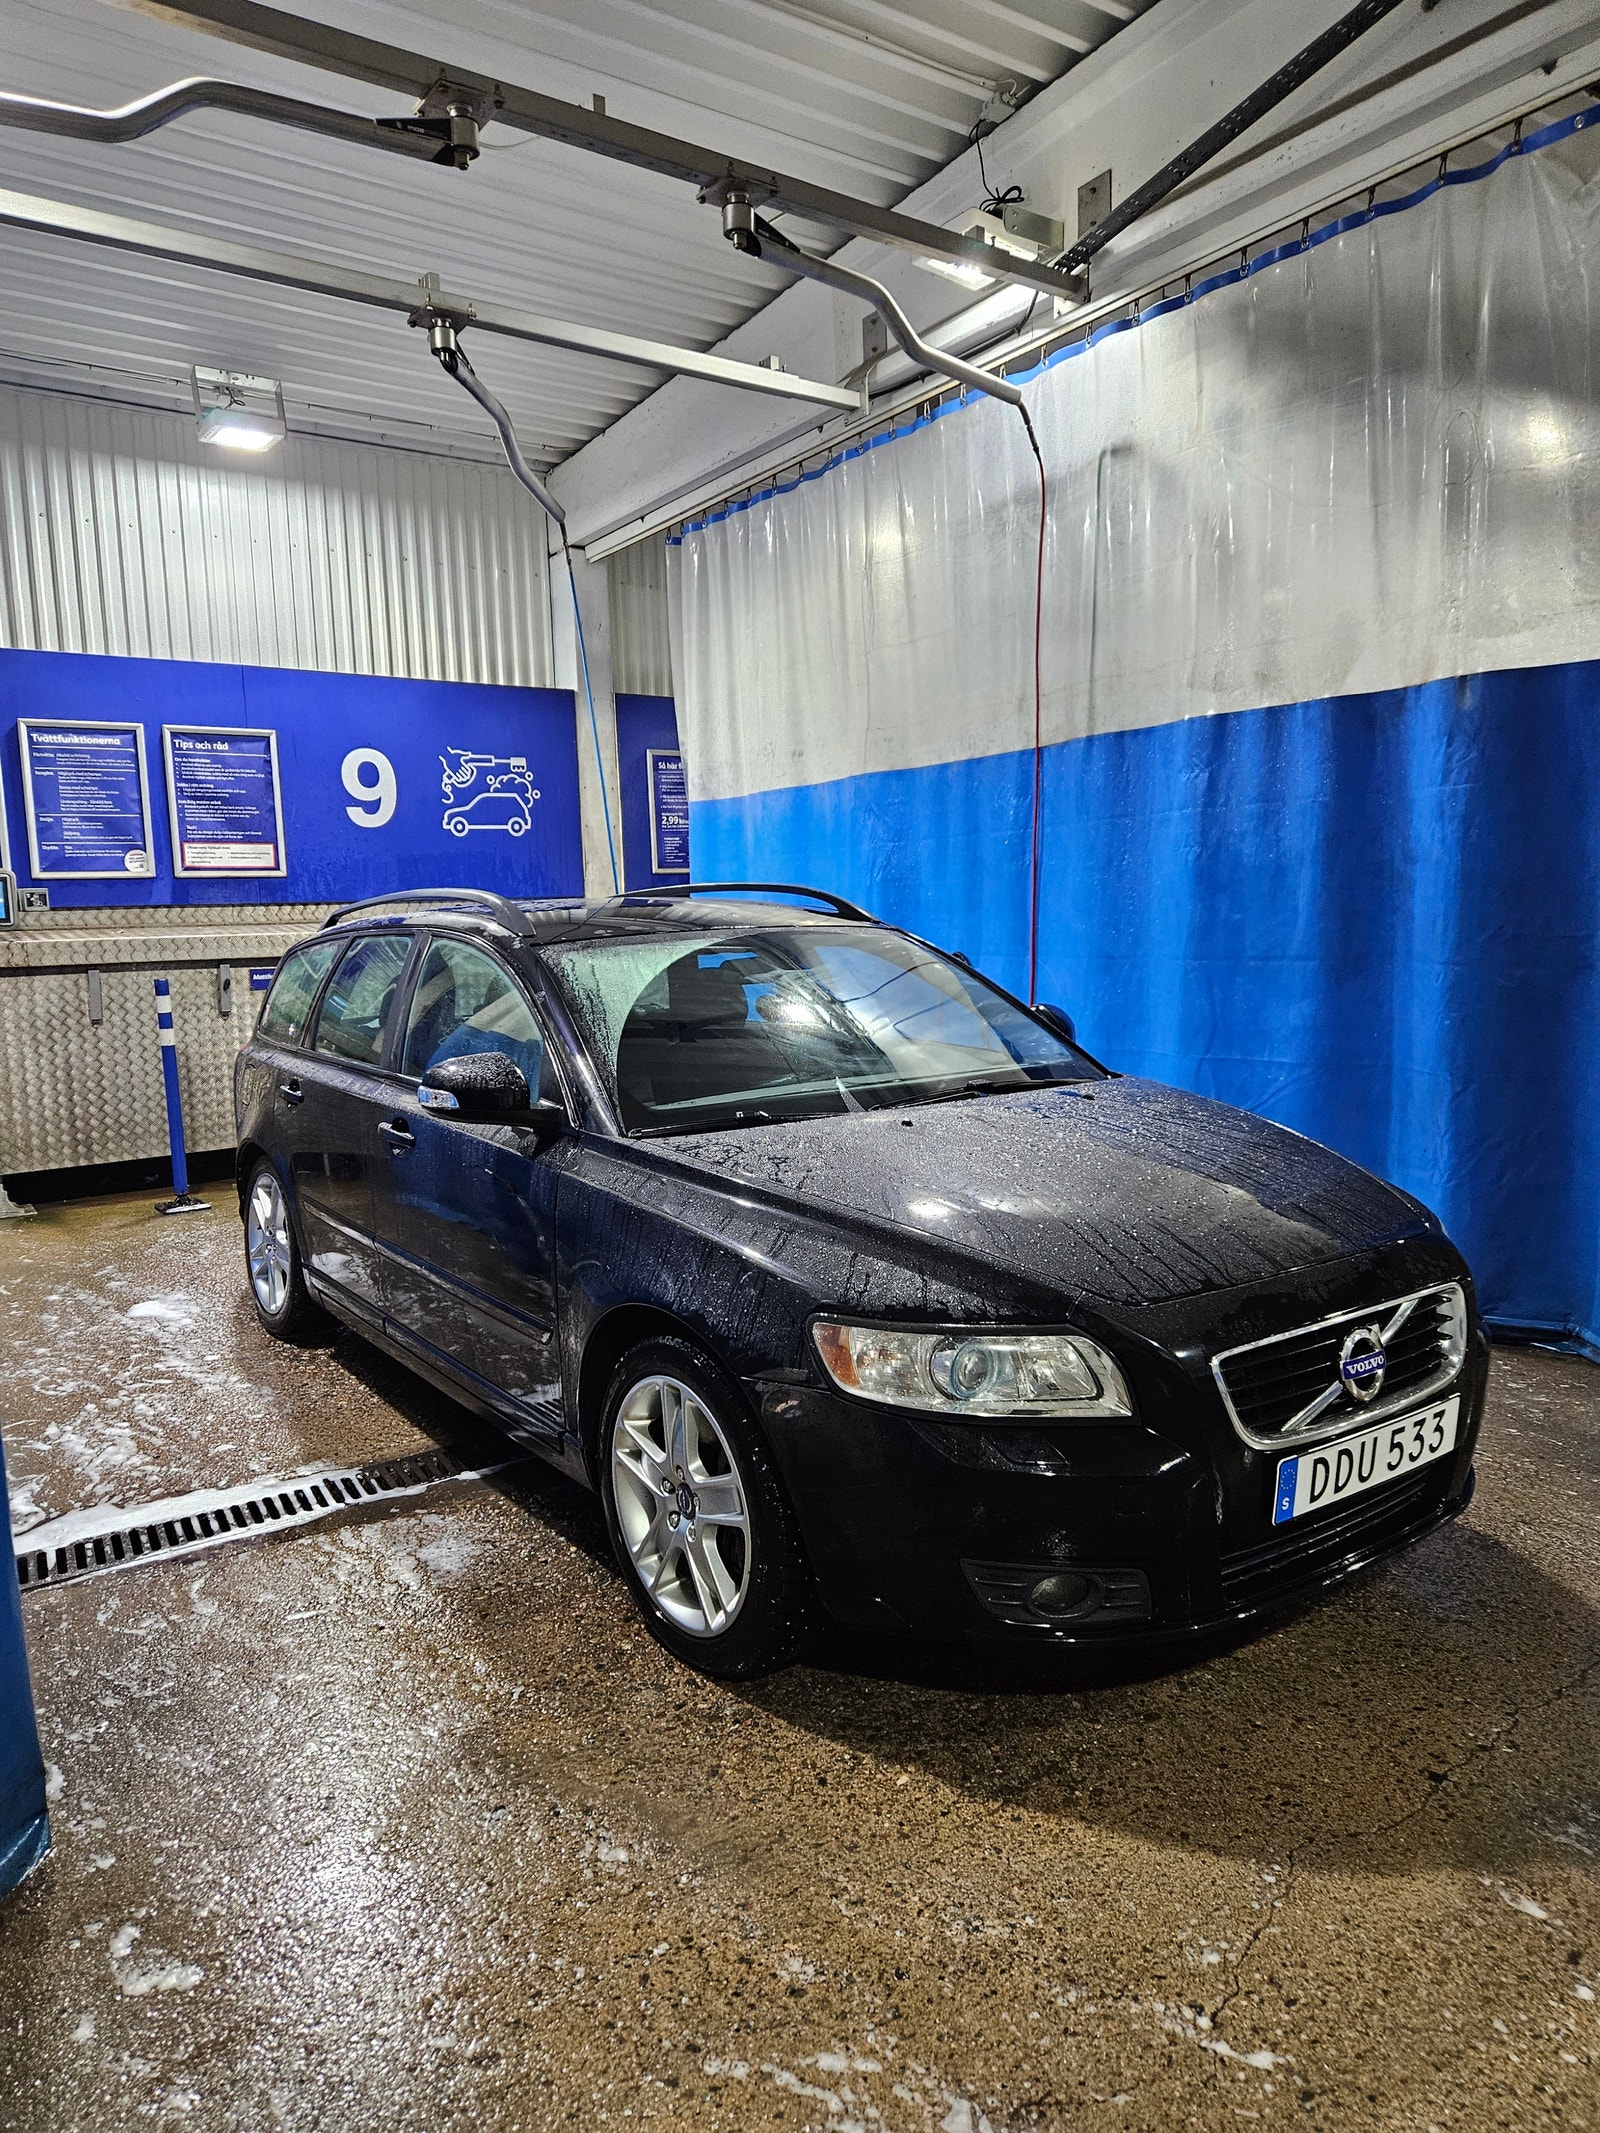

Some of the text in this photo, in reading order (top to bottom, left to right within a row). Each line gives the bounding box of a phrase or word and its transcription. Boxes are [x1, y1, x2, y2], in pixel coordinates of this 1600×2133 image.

[30, 733, 121, 745] Tvättfunktionerna
[173, 739, 229, 750] Tips och råd
[658, 761, 666, 769] Så
[341, 747, 397, 828] 9
[1346, 1354, 1385, 1374] VOLVO
[1309, 1409, 1446, 1504] DDU 533
[1281, 1497, 1290, 1510] S
